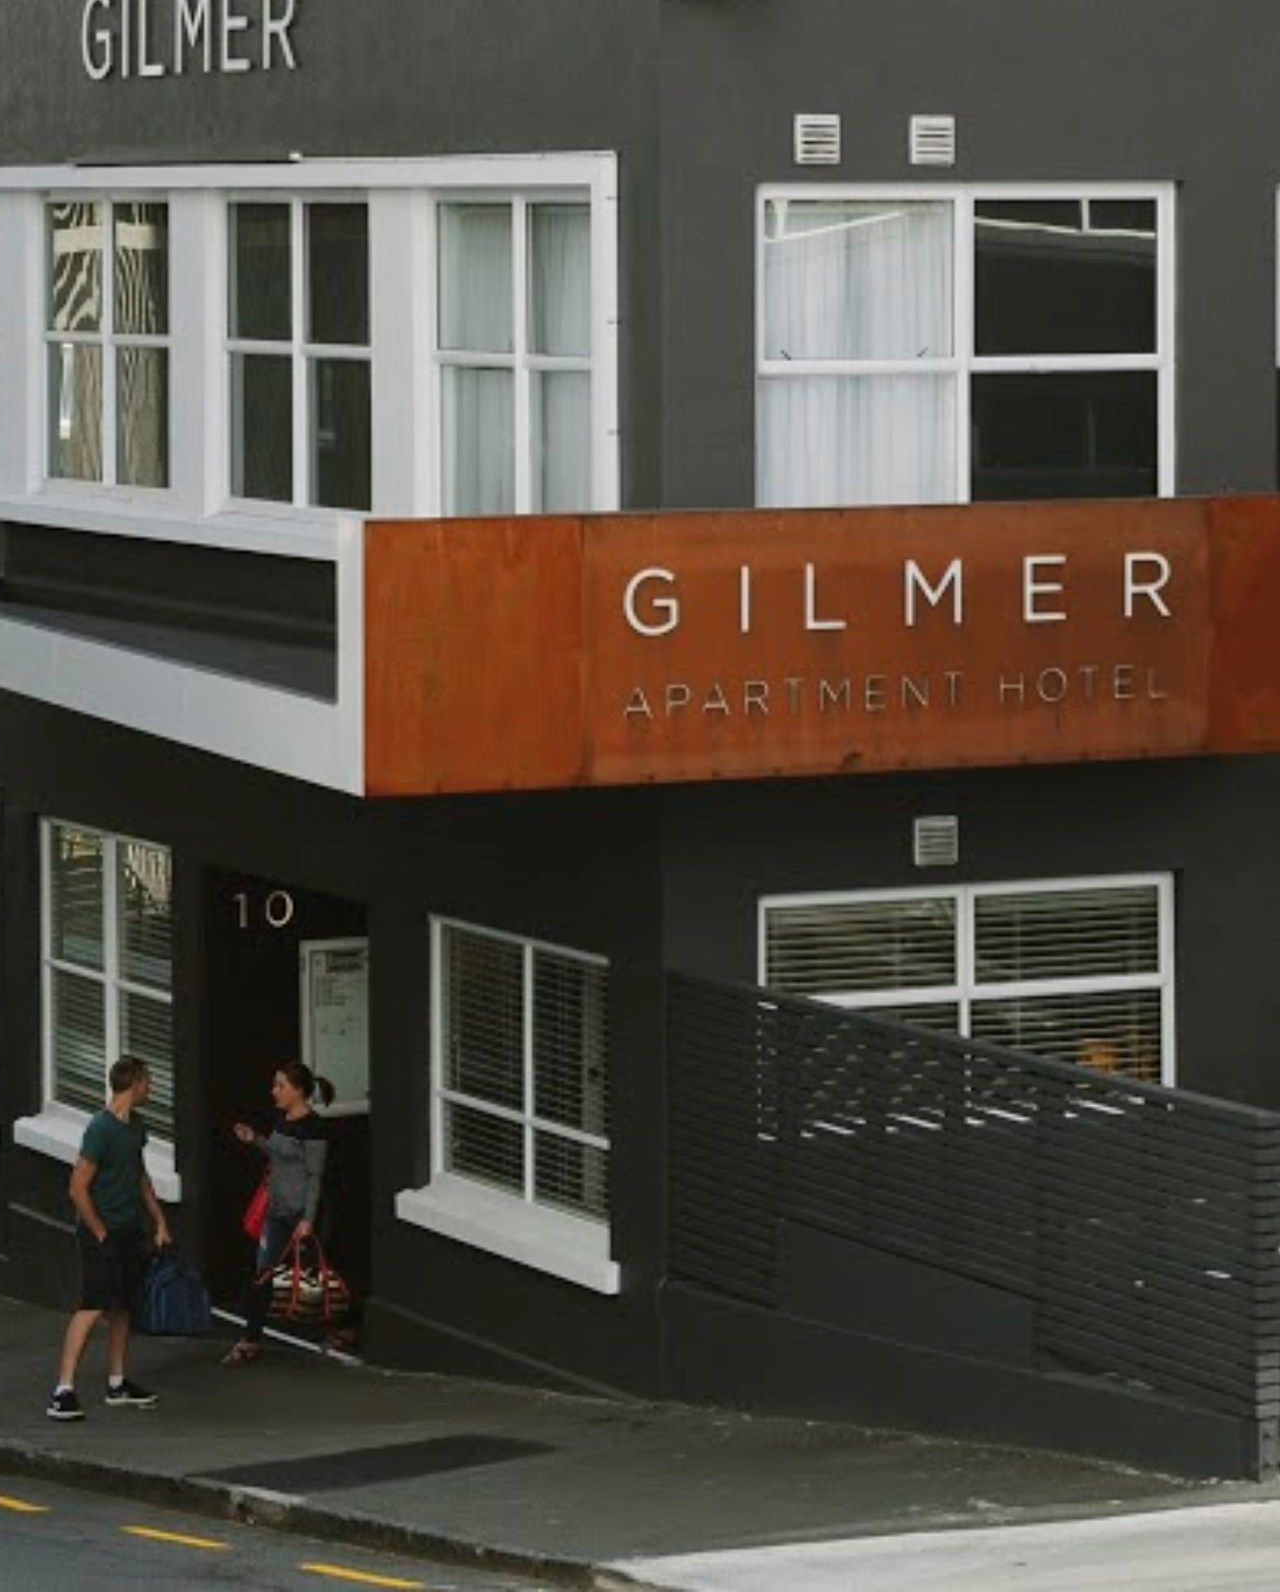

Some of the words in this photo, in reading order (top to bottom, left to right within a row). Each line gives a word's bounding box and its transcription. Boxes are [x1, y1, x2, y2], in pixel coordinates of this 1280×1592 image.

[624, 551, 1171, 636] GILMER
[624, 670, 964, 718] APARTMENT
[999, 664, 1168, 703] HOTEL
[233, 890, 294, 928] 10
